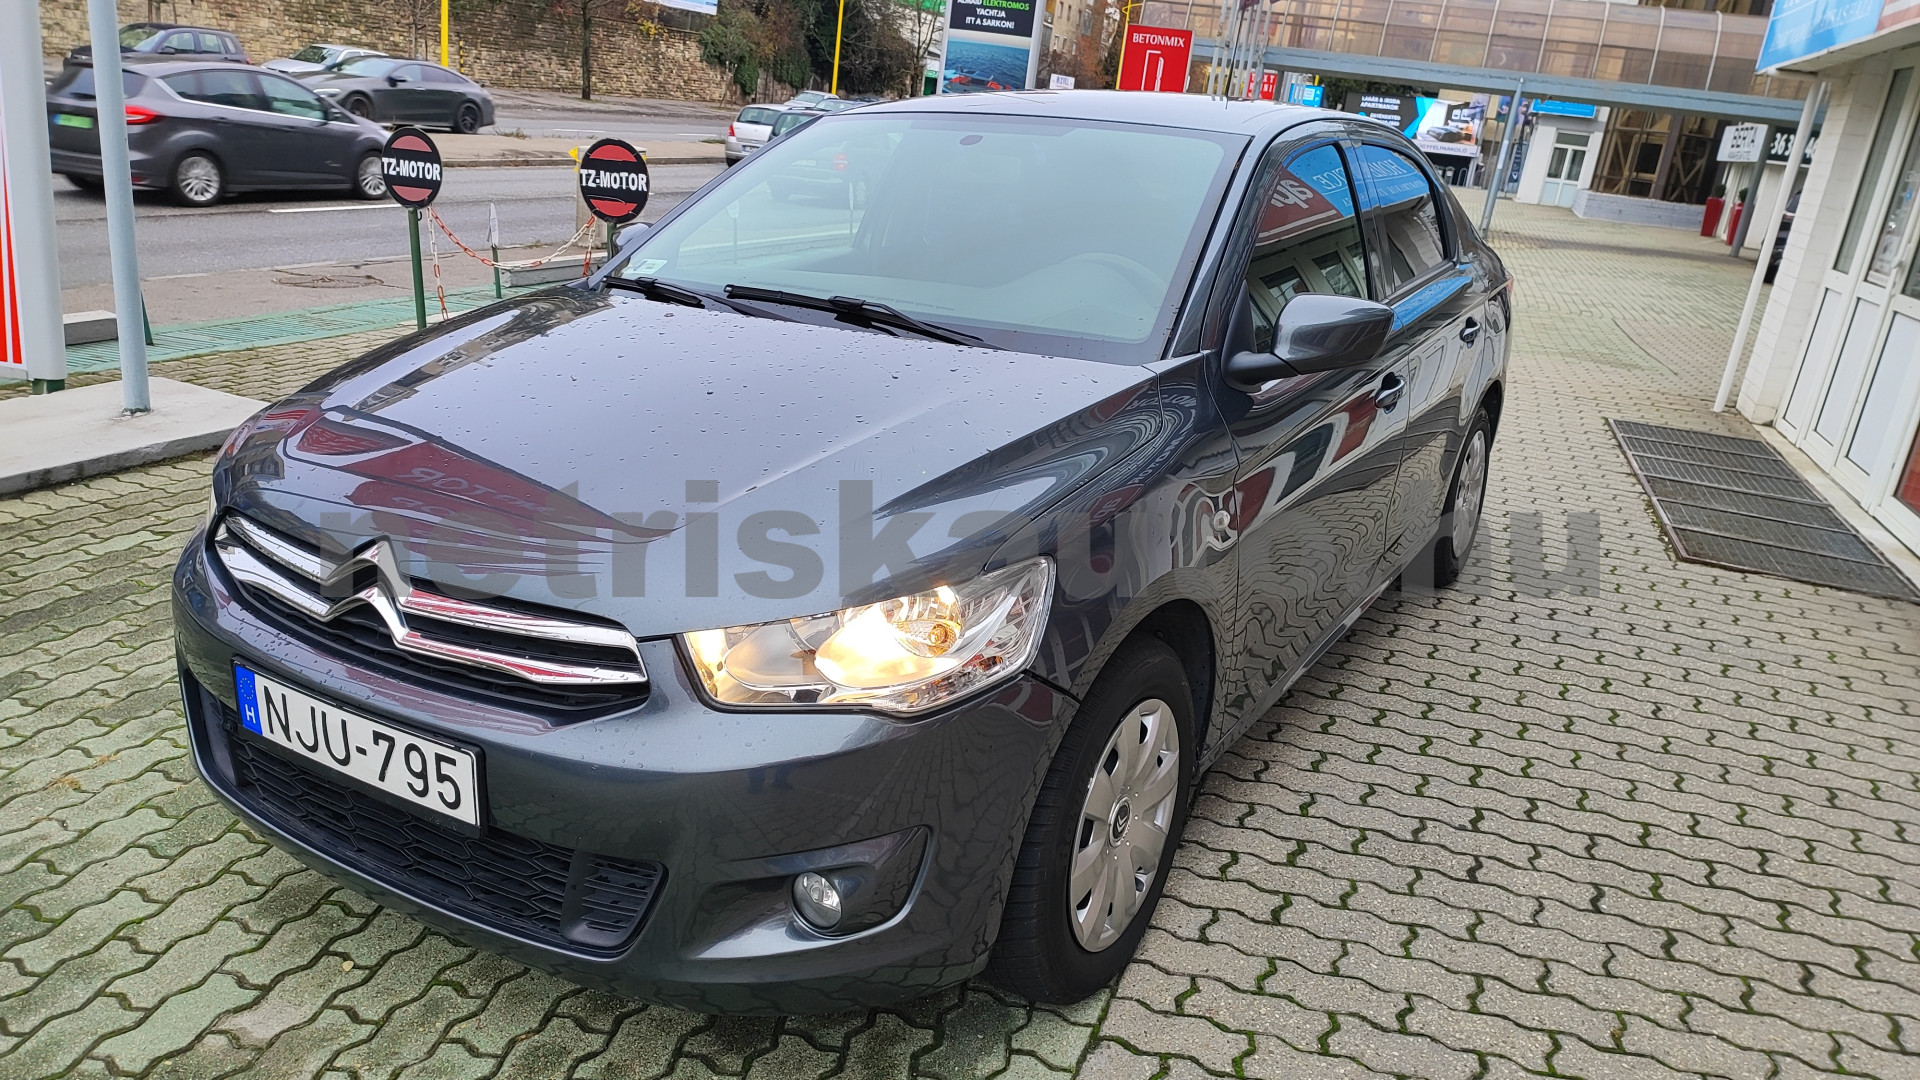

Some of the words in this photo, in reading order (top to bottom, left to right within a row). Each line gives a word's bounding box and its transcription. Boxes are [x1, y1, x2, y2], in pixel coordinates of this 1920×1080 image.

[965, 17, 975, 25] ITT
[976, 8, 1006, 18] YACHTJA
[1132, 33, 1185, 48] BETONMIX
[382, 157, 441, 182] TZ-MOTOR
[580, 168, 648, 193] TZ-MOTOR
[244, 703, 256, 724] H
[263, 685, 461, 811] NJU-795
